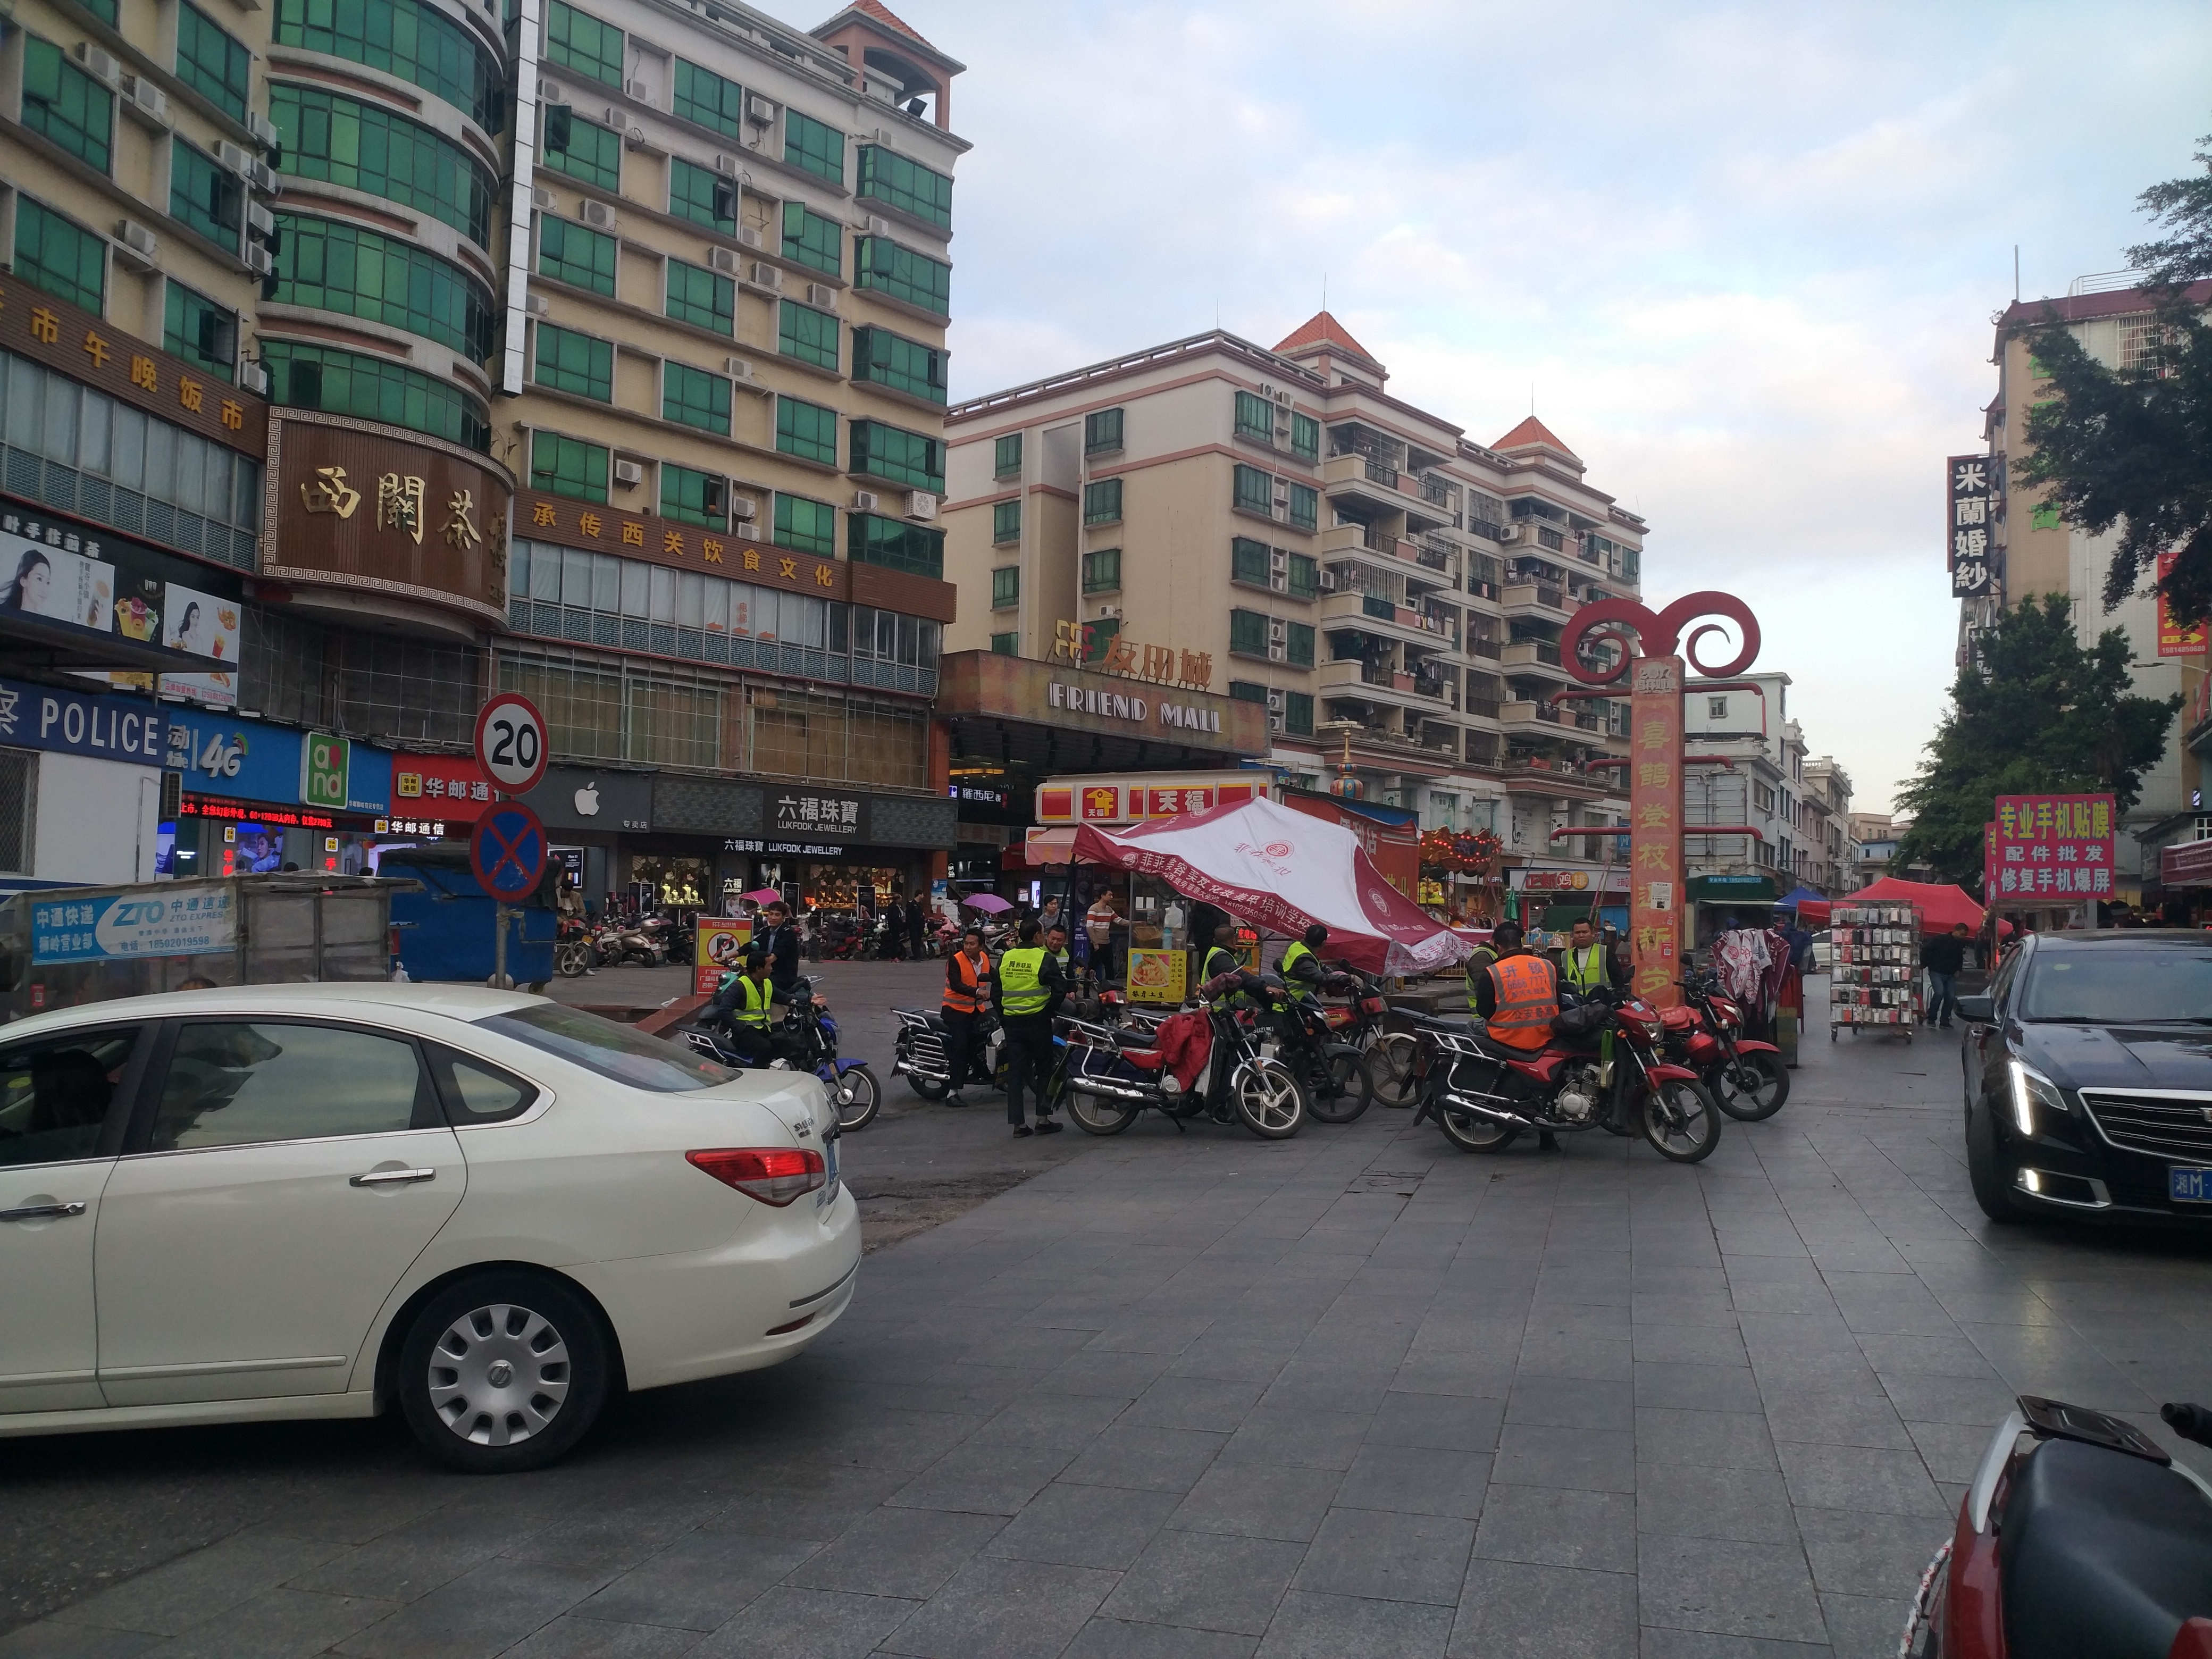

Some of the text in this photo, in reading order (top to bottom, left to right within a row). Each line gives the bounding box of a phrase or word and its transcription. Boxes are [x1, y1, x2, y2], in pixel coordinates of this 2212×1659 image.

[0, 289, 244, 430] 市午晚饭市
[1954, 463, 1988, 591] 米蘭婚紗
[533, 502, 833, 587] 承传西关饮食文化
[1050, 682, 1222, 733] FRIEND MALL
[41, 698, 158, 756] POLICE
[199, 733, 240, 777] 4G
[491, 719, 538, 768] 20
[777, 795, 859, 824] 六福珠寶
[1159, 791, 1204, 812] 天福
[391, 820, 445, 835] 华邮通信
[623, 820, 648, 830] 专卖店
[777, 820, 858, 834] LUKFOOK JEWELLERY
[2000, 801, 2110, 840] 专业手机贴膜
[724, 839, 843, 856] 六福珠寶 LUKFOOK JEWELLERY
[2005, 845, 2104, 862] 配件批发
[724, 877, 742, 889] 六福
[1525, 872, 1587, 889] 正新鸡排
[2000, 867, 2110, 893] 修复手机爆屏
[37, 904, 95, 929] 中通快递
[112, 900, 165, 927] ZTO
[170, 911, 224, 923] ZTO EXPRES
[148, 936, 210, 949] 18502019598
[1132, 990, 1164, 999] 狼牙土豆
[792, 1116, 814, 1132] SYLPH
